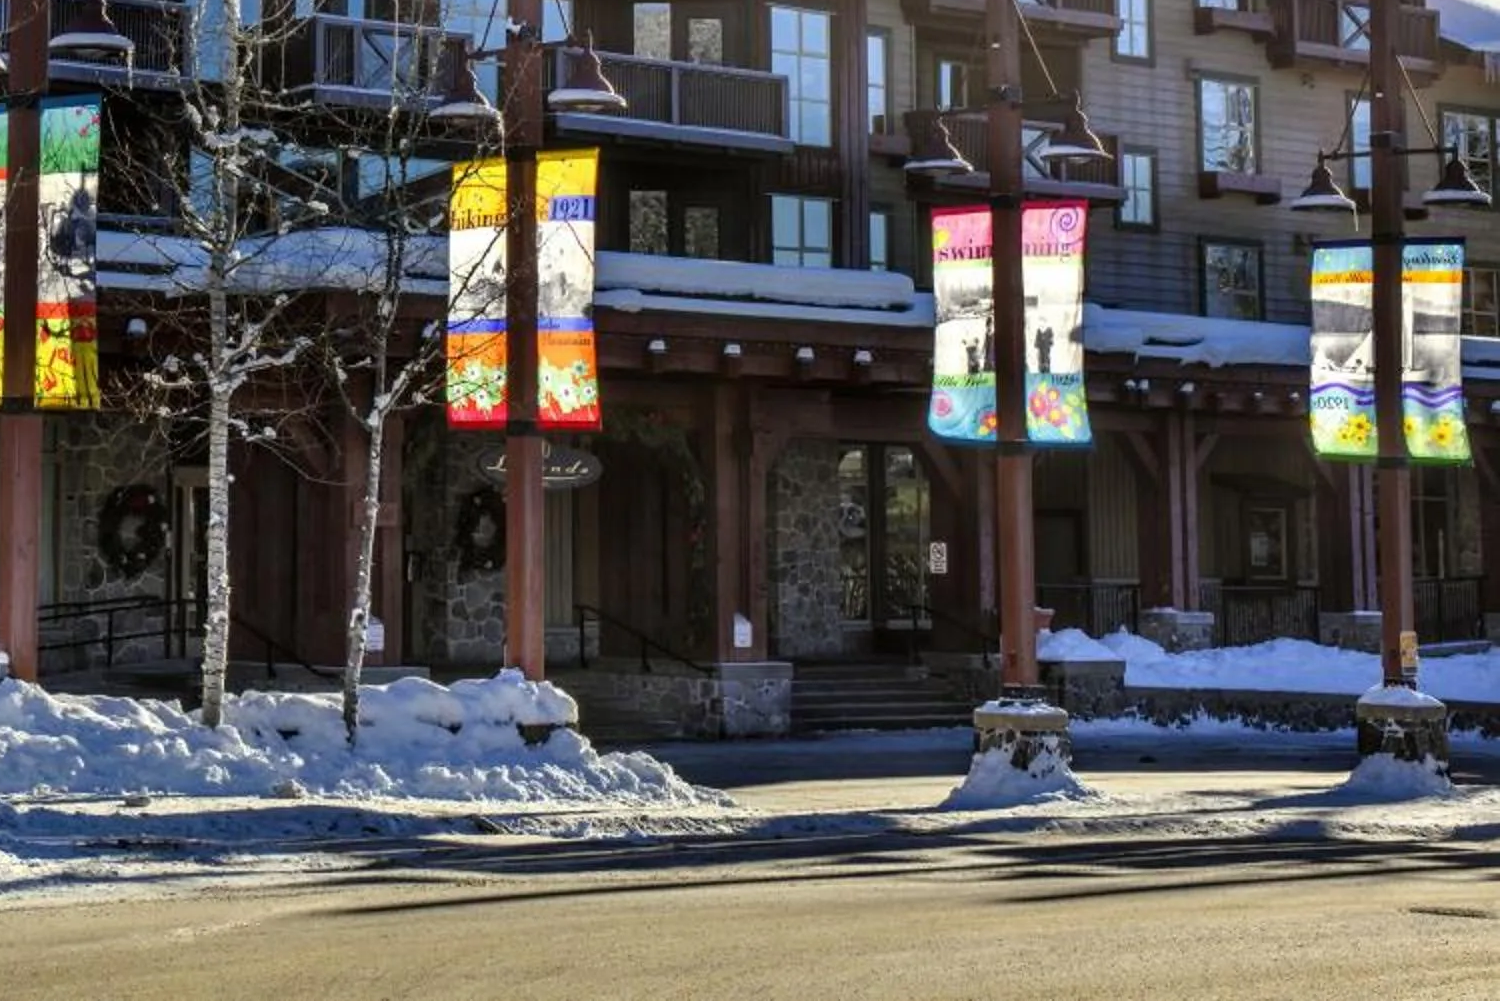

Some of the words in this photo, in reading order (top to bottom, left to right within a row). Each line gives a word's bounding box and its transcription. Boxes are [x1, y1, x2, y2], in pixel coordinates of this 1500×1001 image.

[451, 206, 507, 231] hiking
[551, 198, 590, 220] 1921
[486, 455, 589, 476] Lnds
